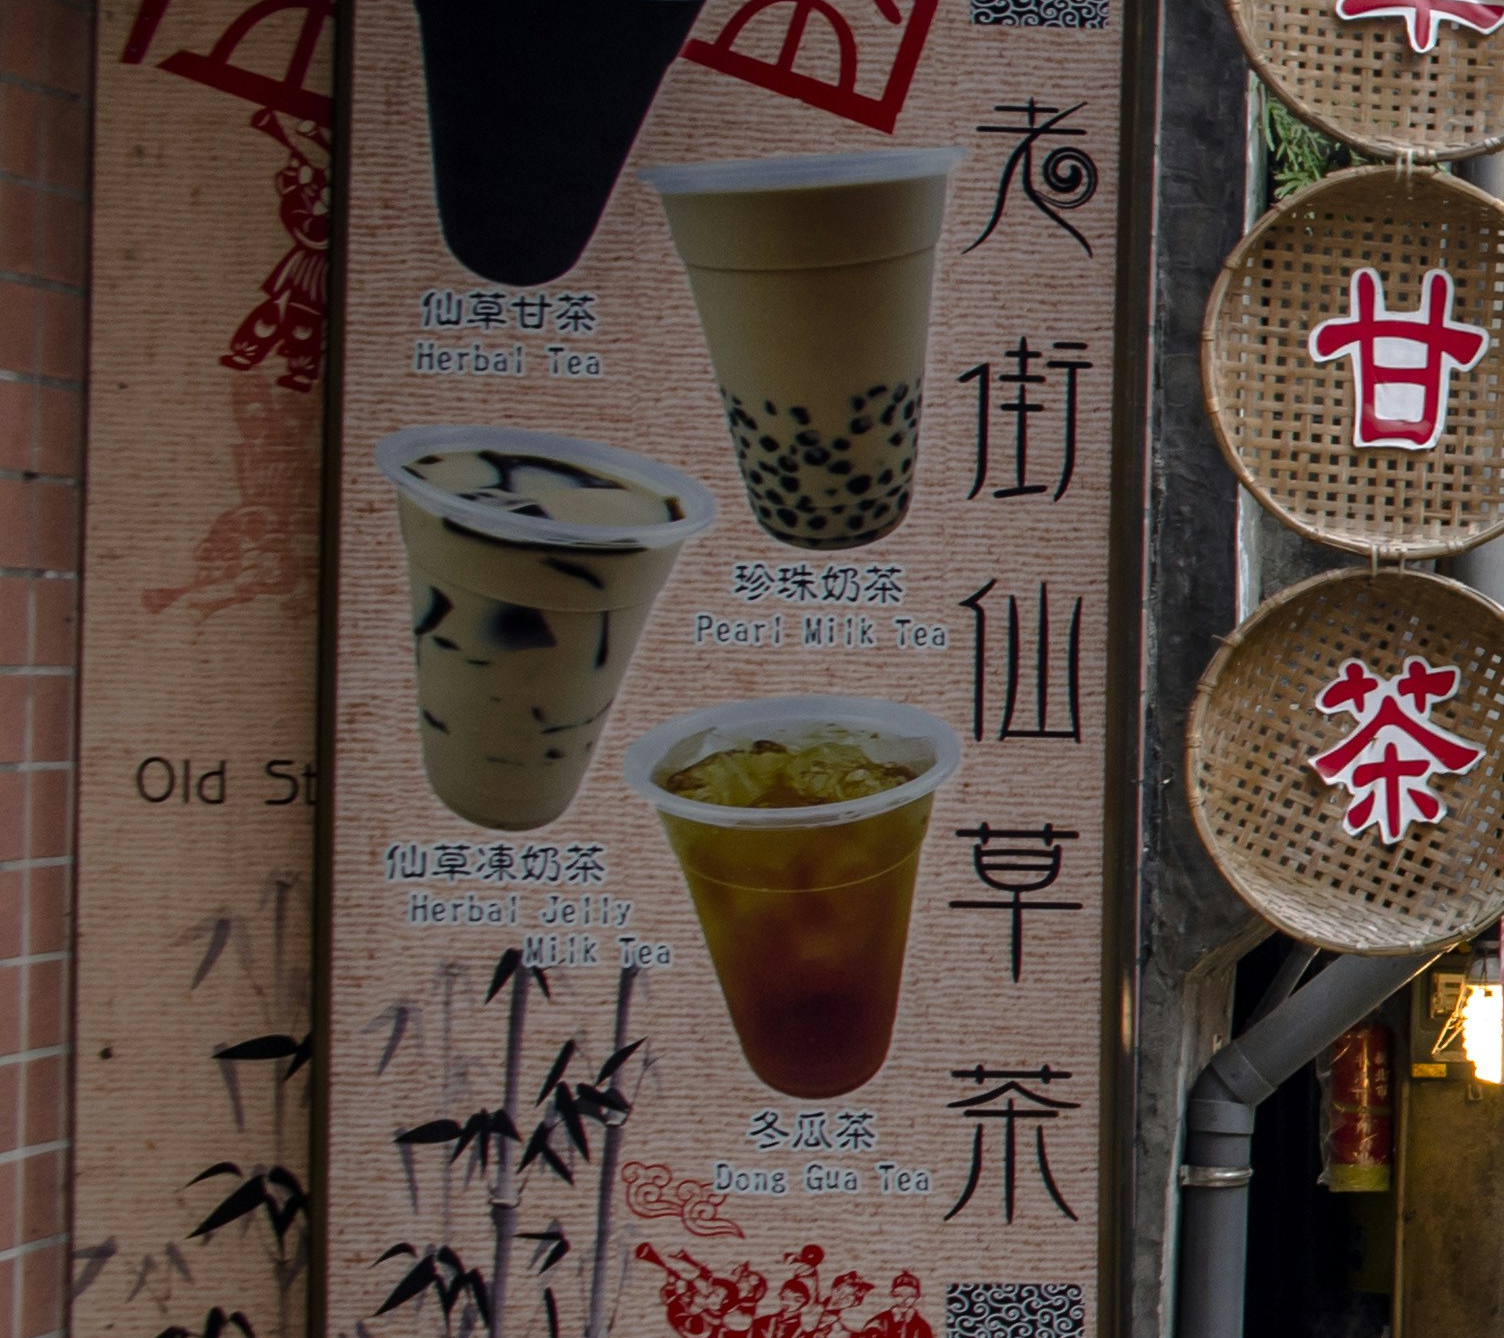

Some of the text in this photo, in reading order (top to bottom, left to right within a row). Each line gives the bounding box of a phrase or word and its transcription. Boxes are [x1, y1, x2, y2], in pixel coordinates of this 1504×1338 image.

[420, 291, 599, 334] 仙草甘茶
[415, 341, 602, 378] Herbal Tea
[1311, 267, 1486, 449] 甘
[733, 561, 906, 606] 珍珠奶茶
[695, 611, 949, 650] Pearl Milk Tea
[944, 98, 1100, 1225] 老街仙草茶
[1308, 656, 1481, 841] 茶
[136, 754, 227, 807] Old
[386, 843, 609, 885] 仙草凍奶茶
[408, 893, 634, 929] Herbal Jelly
[523, 935, 675, 969] Milk Tea
[749, 1111, 877, 1153] 冬瓜茶
[712, 1161, 934, 1197] Dong Gua Tea
